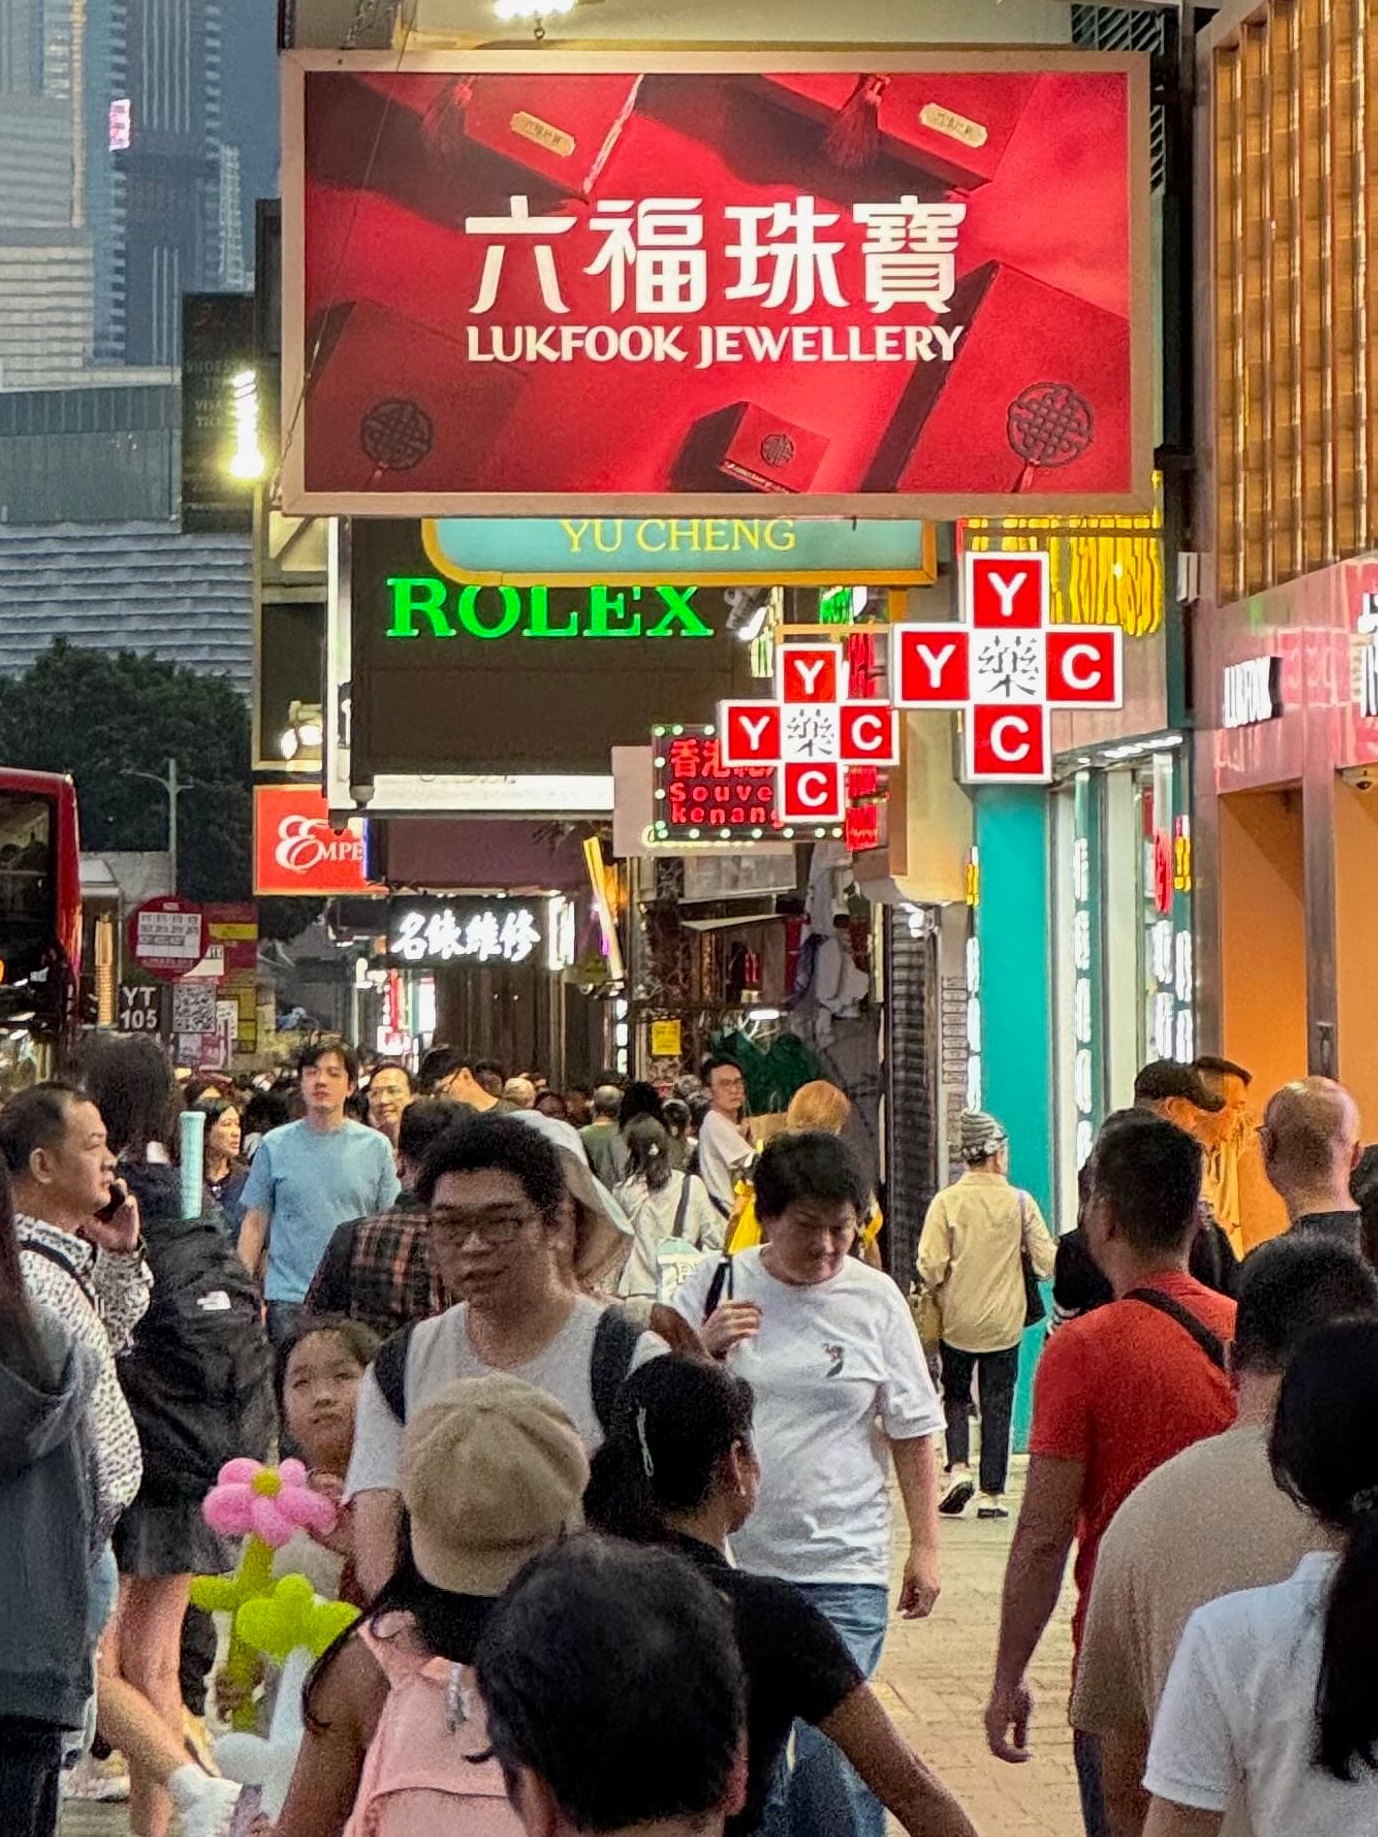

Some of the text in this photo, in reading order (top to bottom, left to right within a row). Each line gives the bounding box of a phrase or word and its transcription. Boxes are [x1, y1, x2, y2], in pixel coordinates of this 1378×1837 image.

[465, 195, 967, 315] 六福珠寶
[466, 325, 964, 370] LUKFOOK JEWELLERY
[560, 518, 797, 553] YU CHENG
[385, 577, 715, 638] ROLEX
[988, 572, 1028, 617] Y
[793, 659, 825, 695] Y
[916, 643, 957, 689] Y
[1062, 643, 1102, 689] C
[738, 715, 771, 751] Y
[851, 714, 883, 751] C
[989, 719, 1028, 766] C
[796, 770, 829, 807] C
[121, 986, 157, 1007] YT
[119, 1009, 158, 1029] 105
